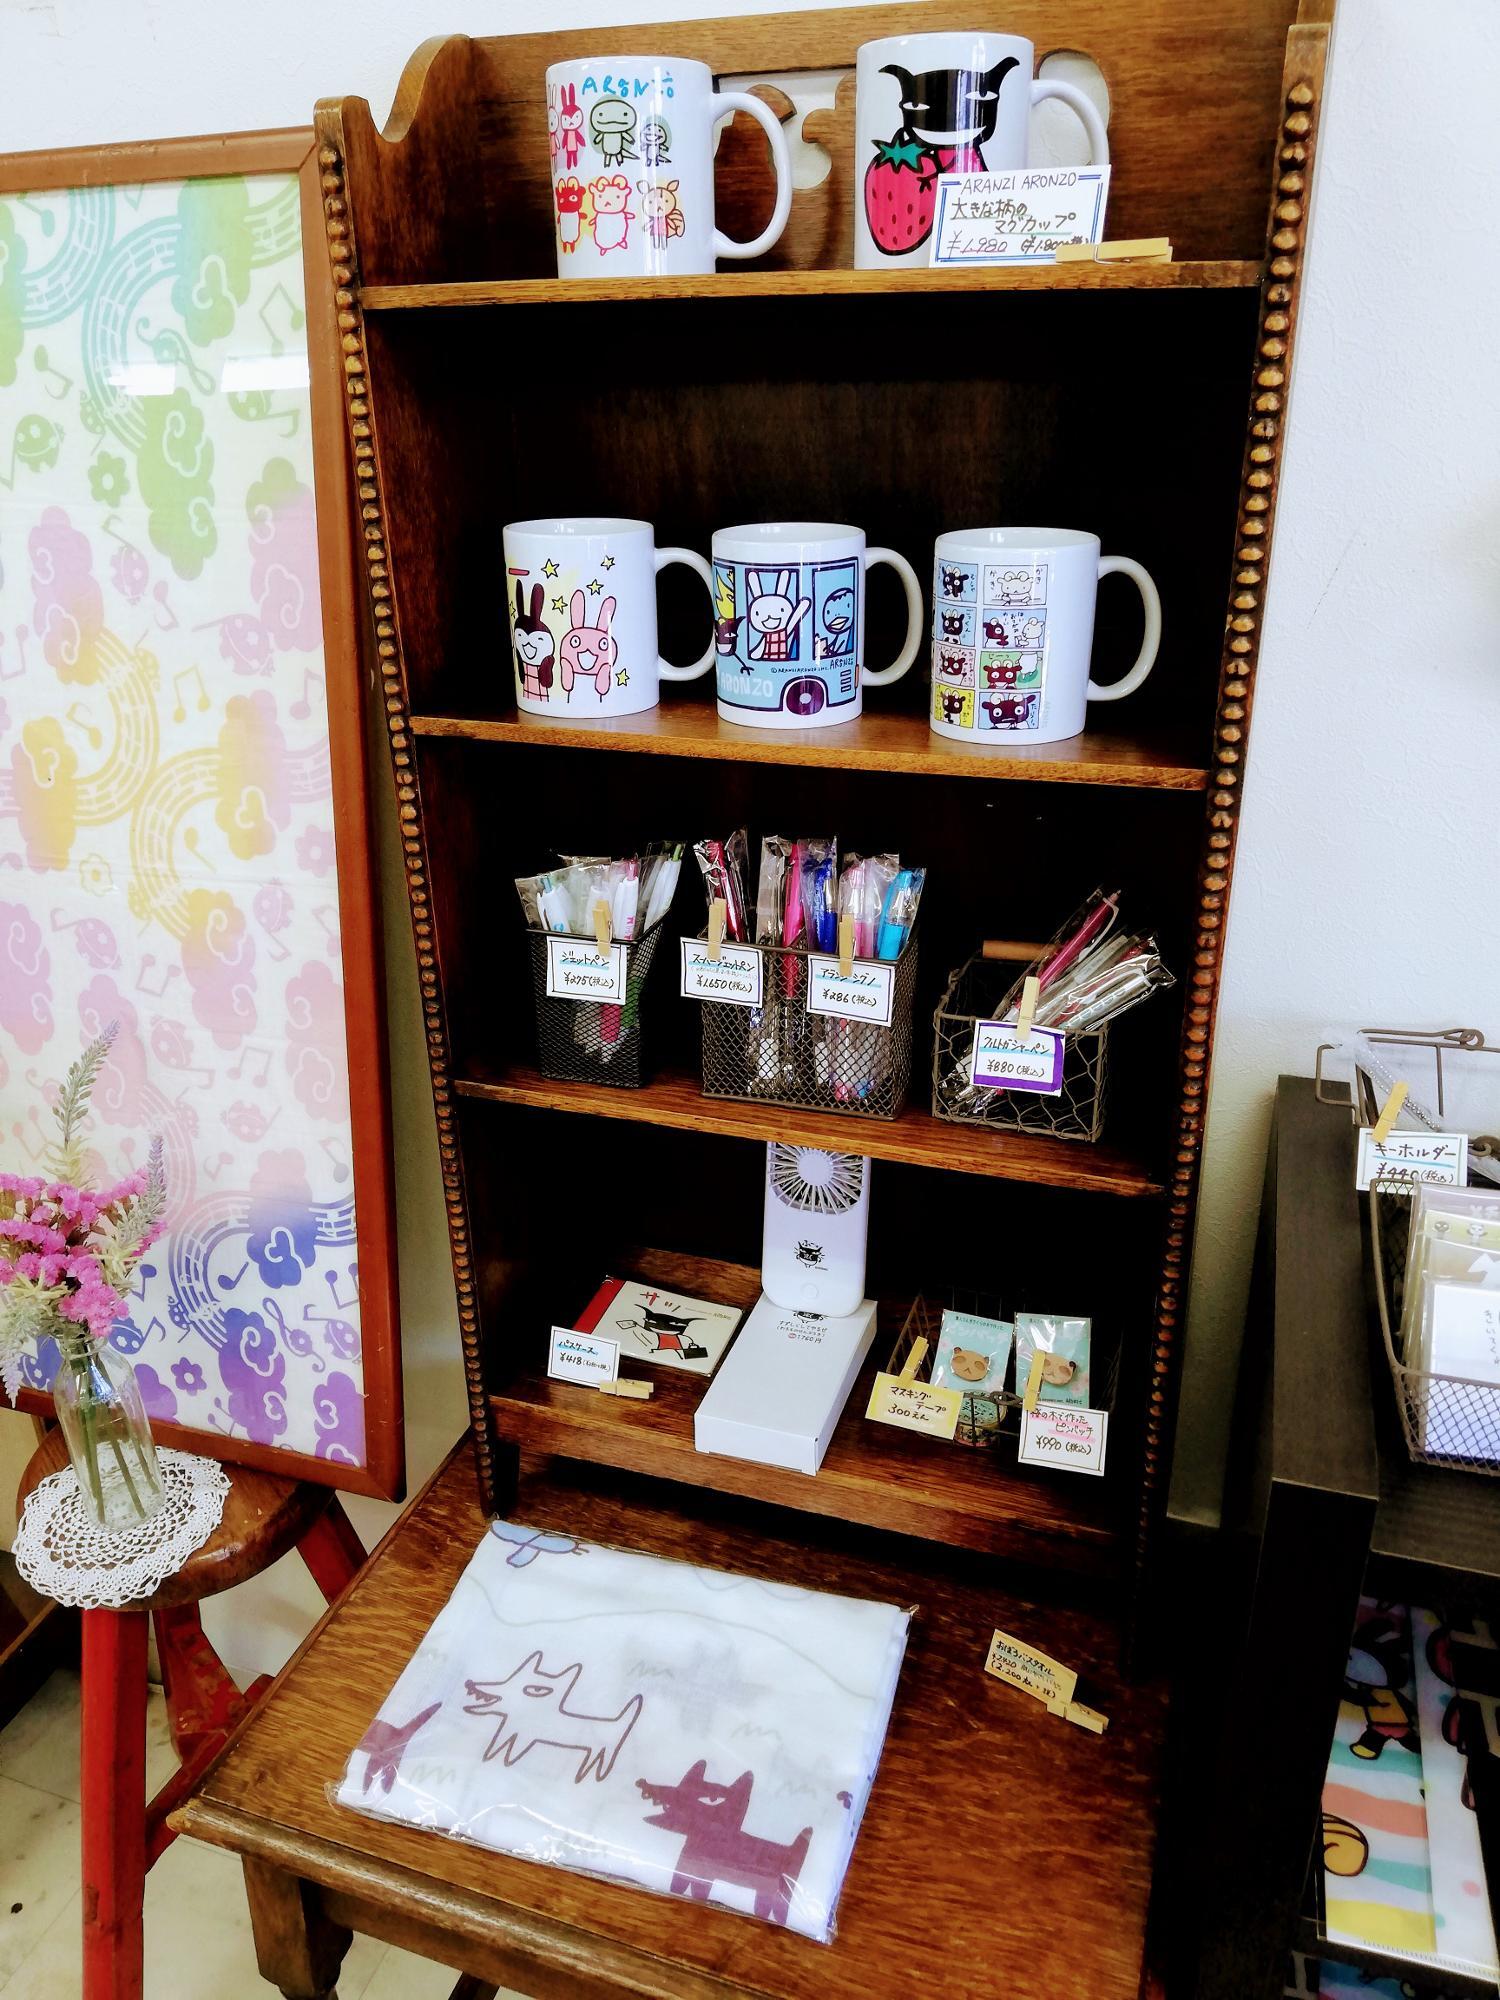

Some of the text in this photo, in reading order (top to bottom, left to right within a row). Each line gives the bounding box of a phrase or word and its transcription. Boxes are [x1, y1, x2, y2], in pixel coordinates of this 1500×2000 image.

[961, 172, 1077, 195] ARANZI ARONZO
[951, 197, 1028, 219] 大きな柄の
[995, 212, 1077, 233] マグカップ
[562, 950, 610, 967] ジェットペン
[1375, 1142, 1457, 1160] キーホルダー
[558, 1339, 597, 1355] パスケース
[890, 1386, 932, 1400] マスキング
[916, 1401, 947, 1413] テープ
